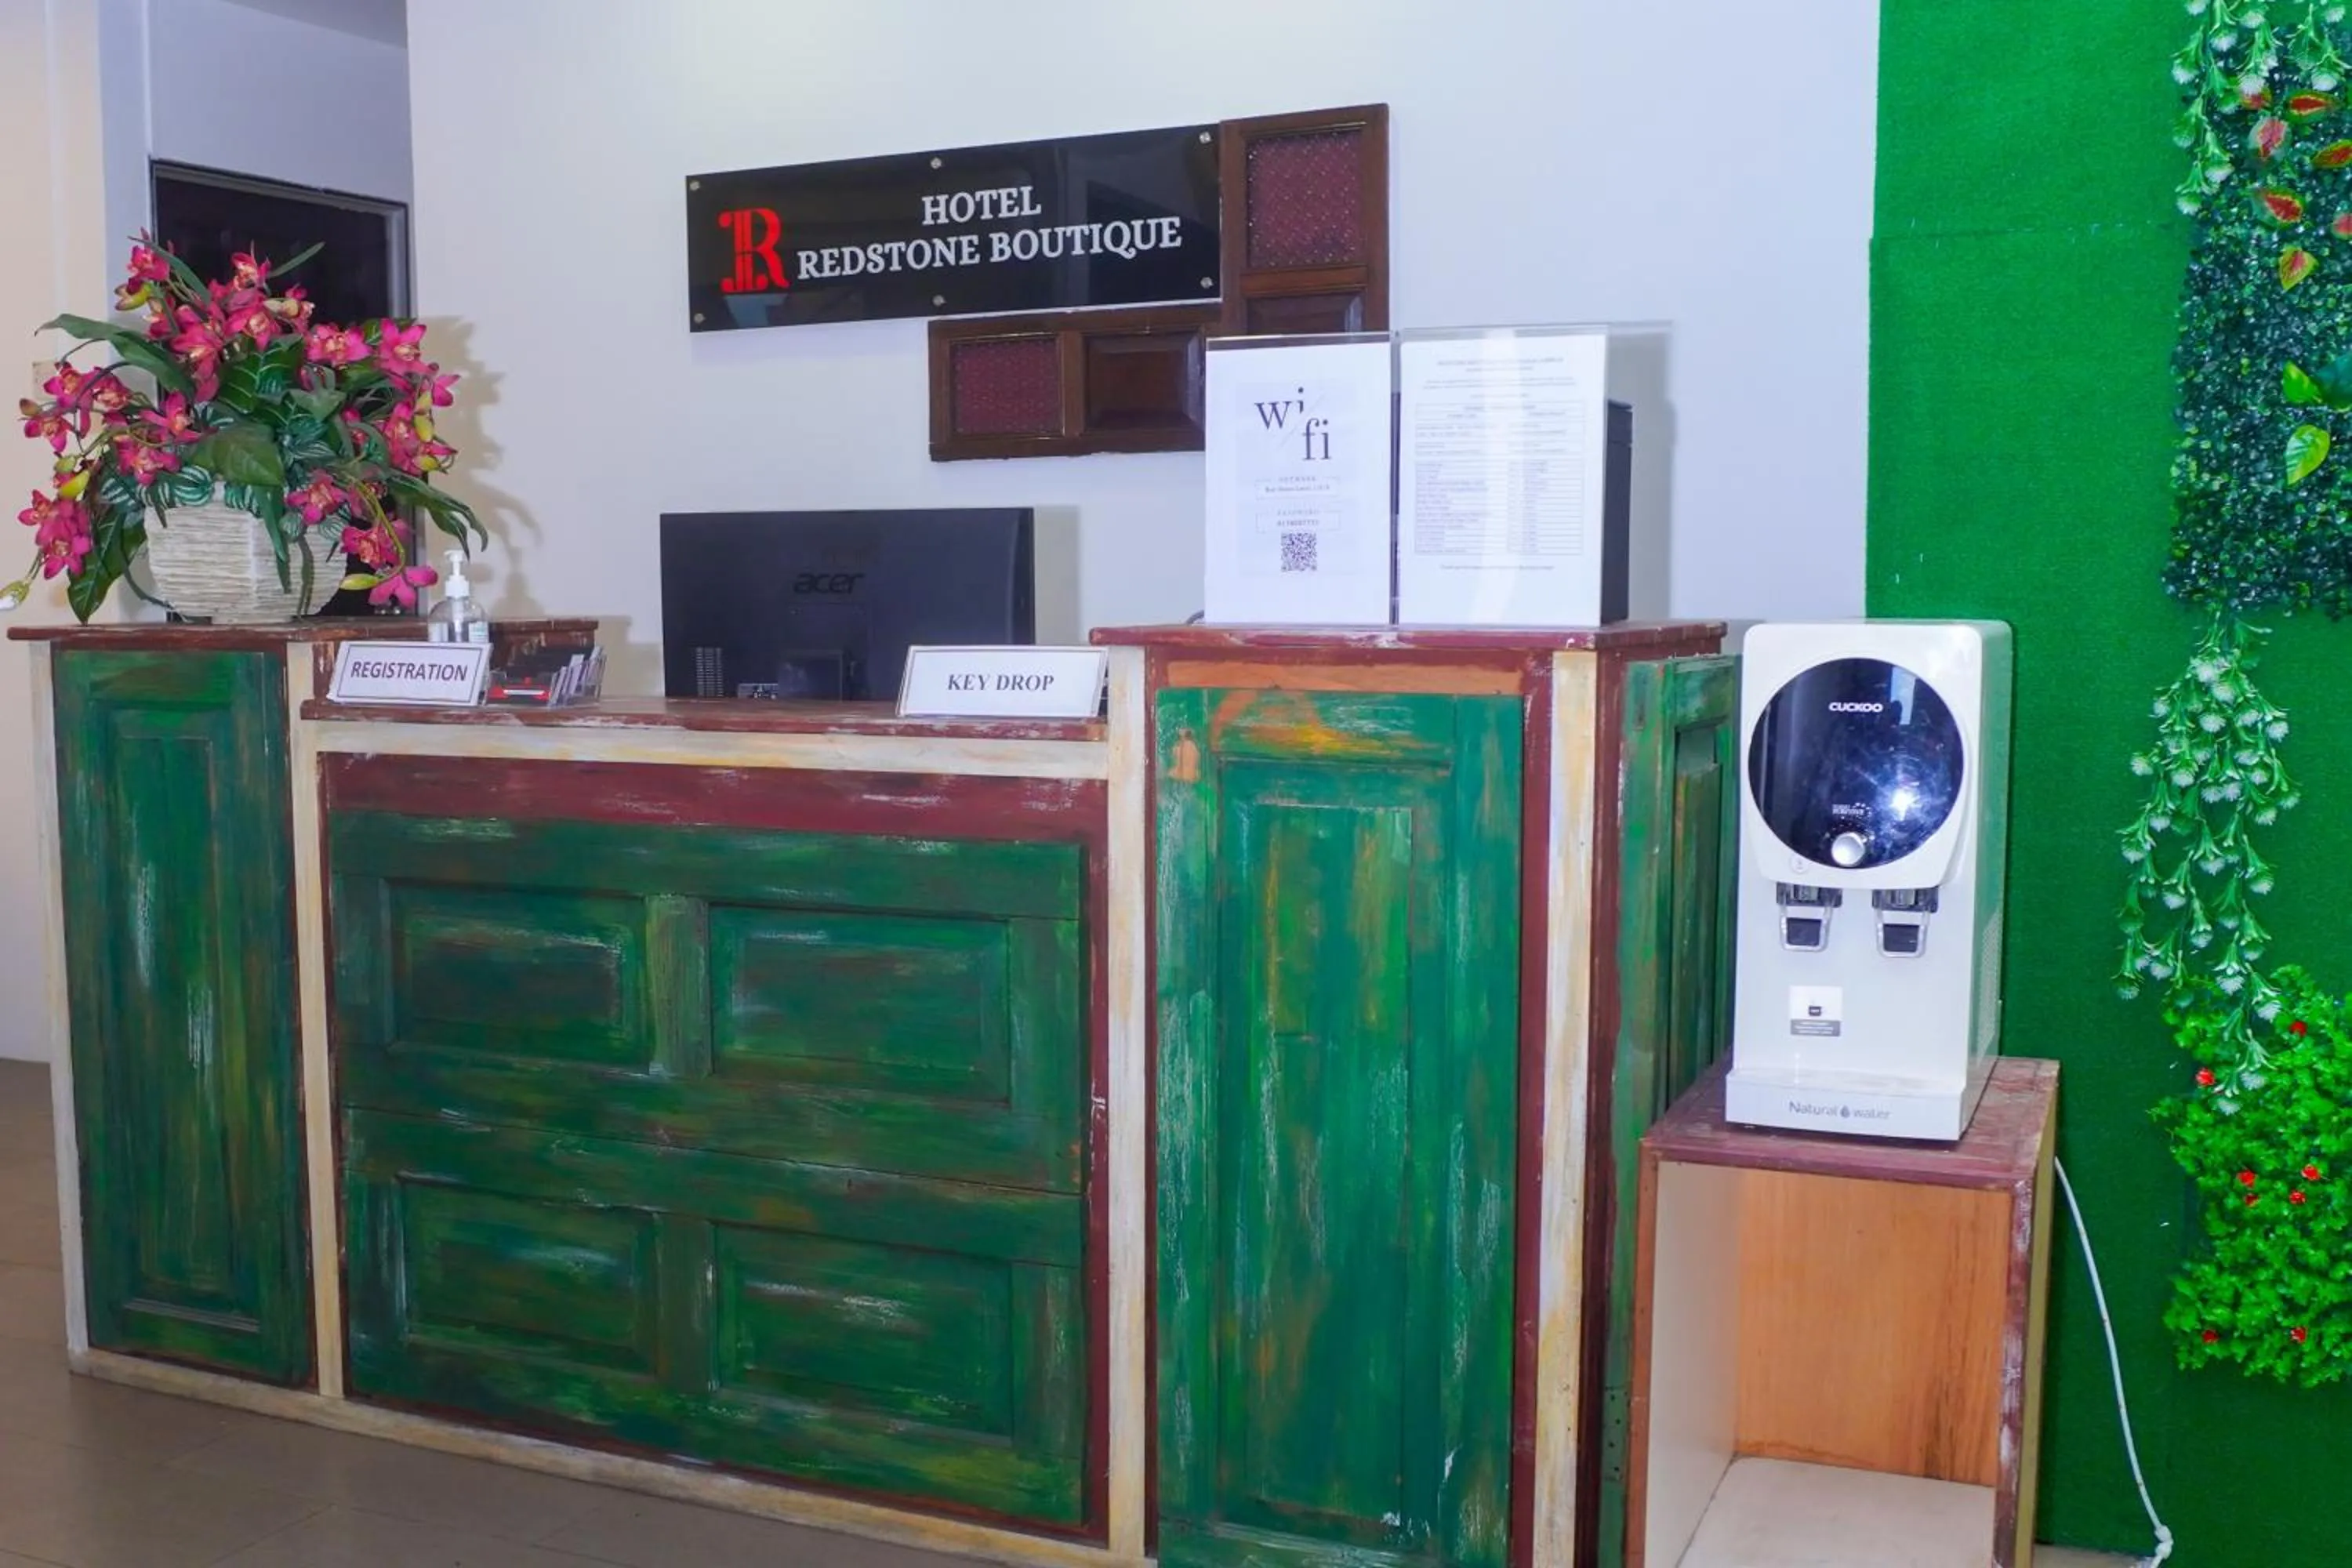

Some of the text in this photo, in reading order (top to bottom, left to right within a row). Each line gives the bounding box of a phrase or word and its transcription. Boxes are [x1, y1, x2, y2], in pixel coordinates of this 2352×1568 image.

[922, 186, 1042, 225] HOTEL
[797, 216, 1182, 279] REDSTONE BOUTIQUE
[794, 573, 866, 594] acer
[350, 661, 468, 681] REGISTRATION
[946, 673, 1054, 691] KEY DROP
[1829, 702, 1883, 713] CUCKOO
[1788, 1100, 1892, 1120] Natural water
